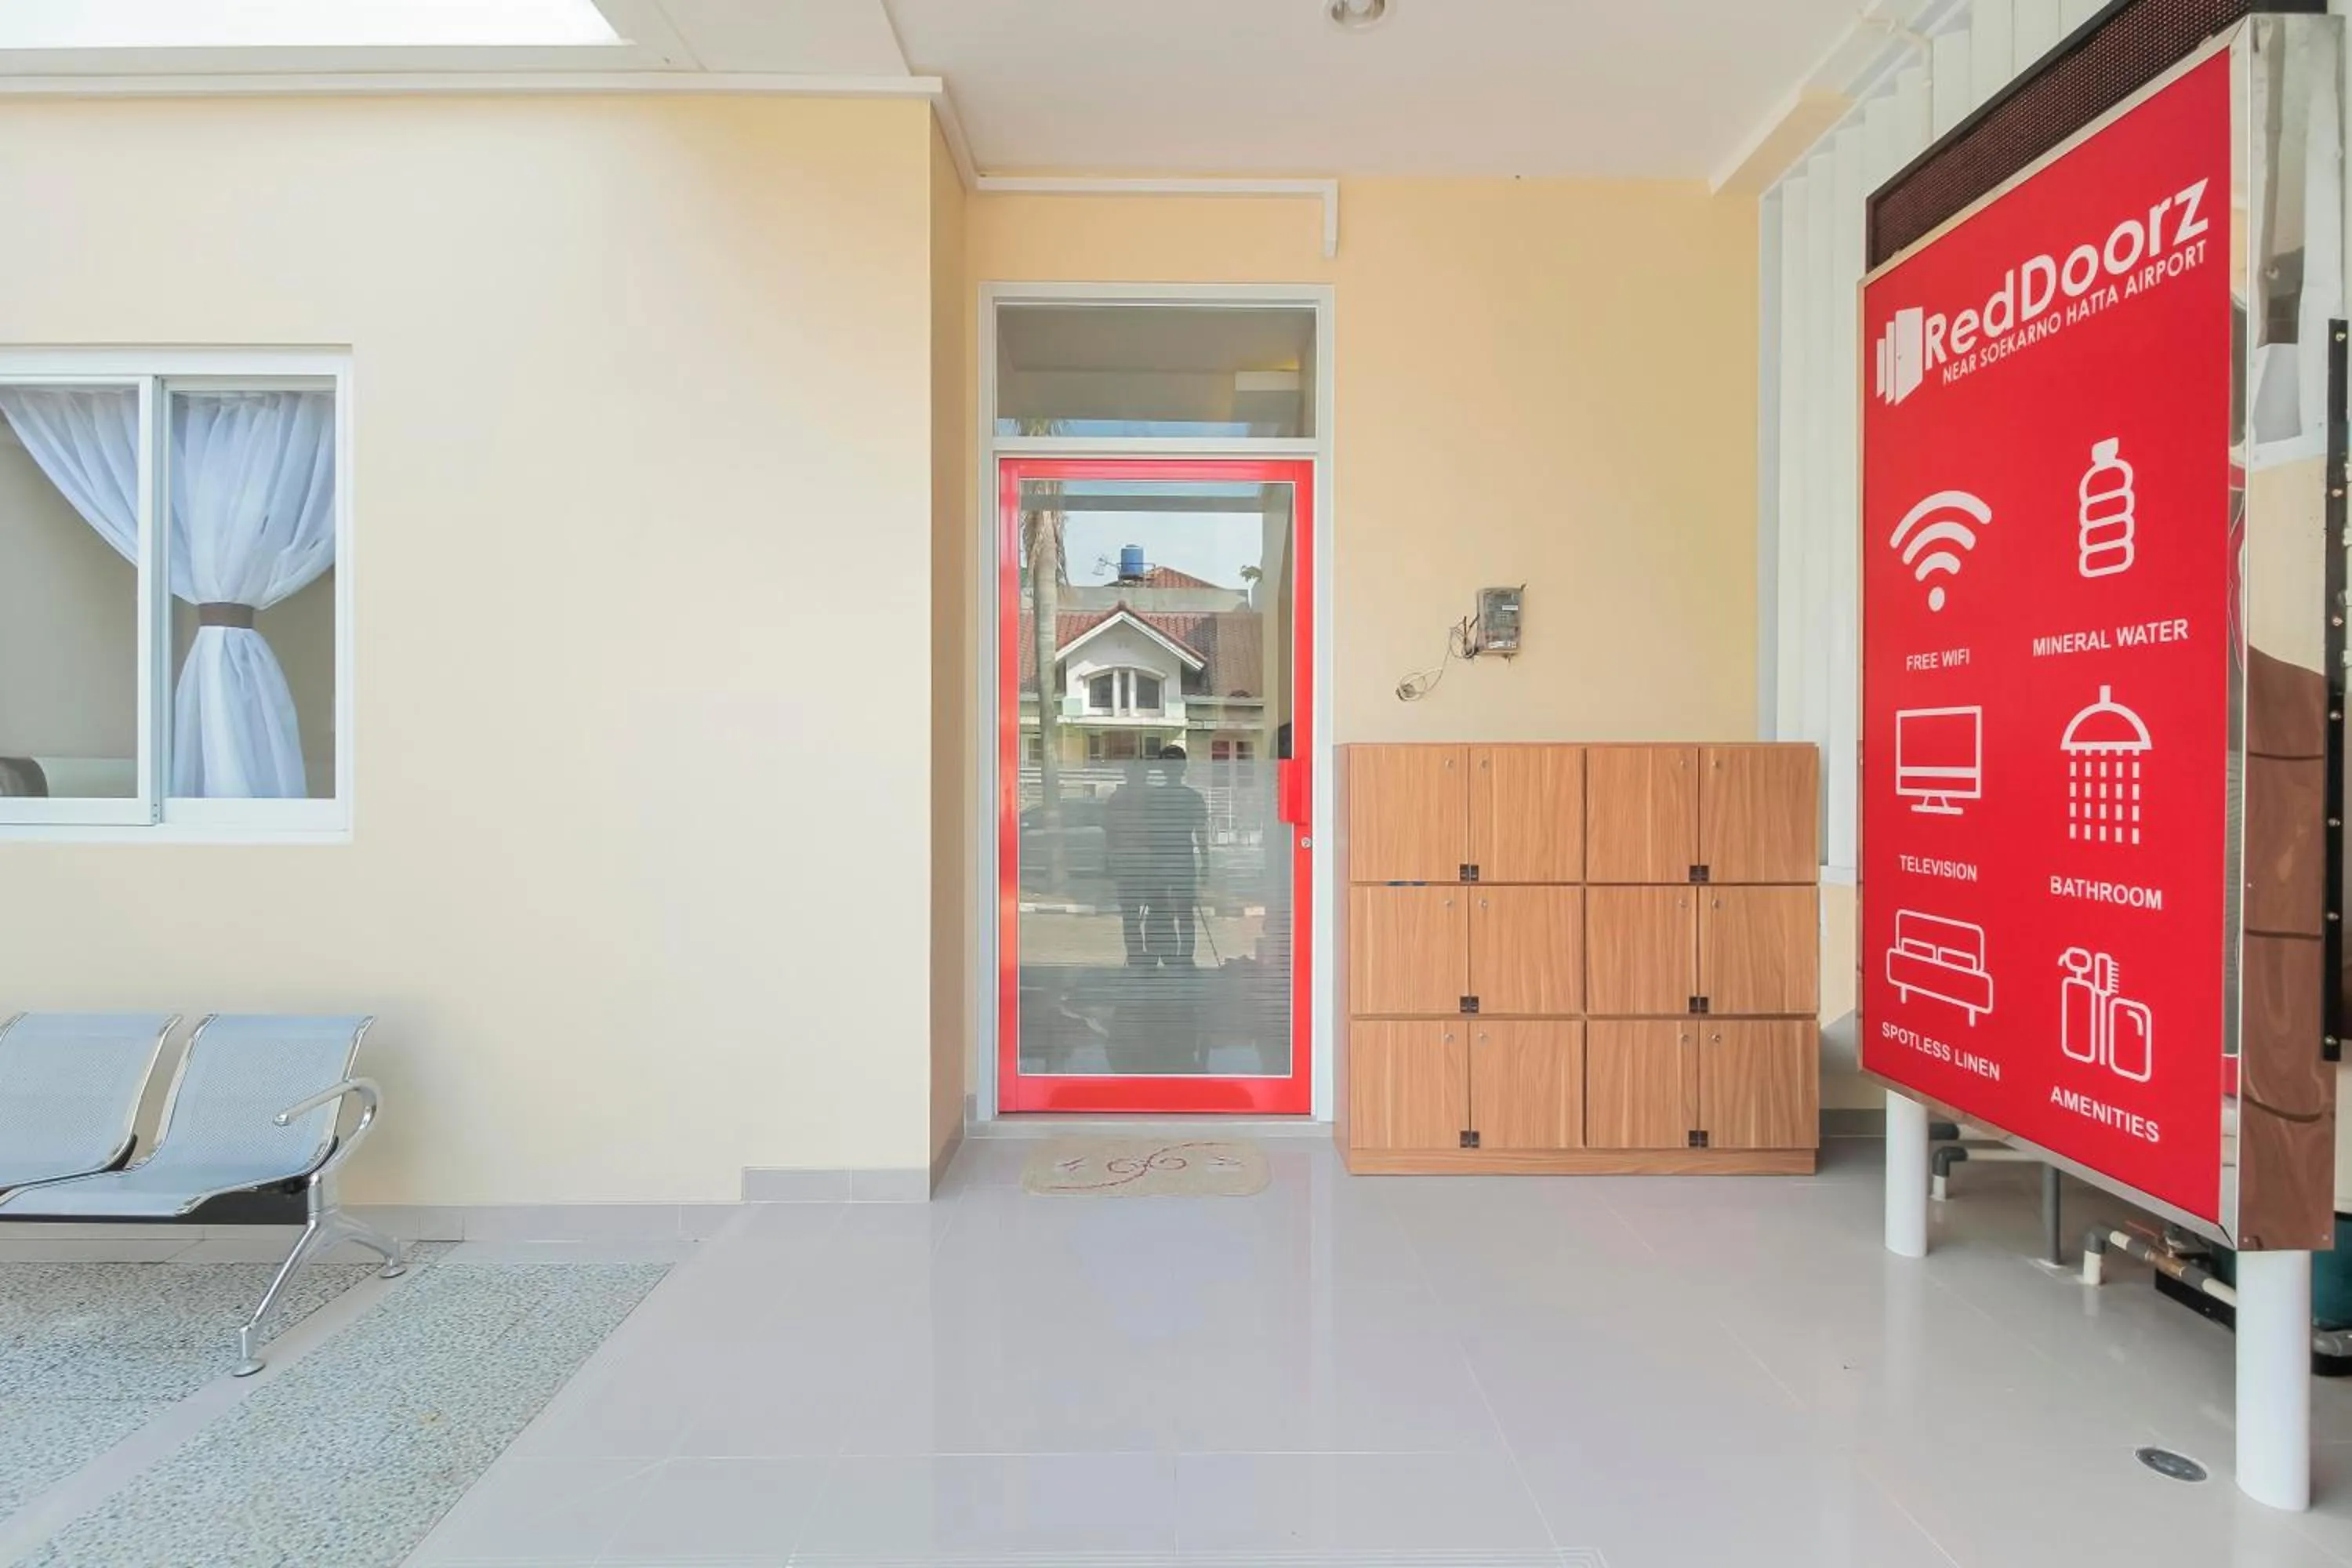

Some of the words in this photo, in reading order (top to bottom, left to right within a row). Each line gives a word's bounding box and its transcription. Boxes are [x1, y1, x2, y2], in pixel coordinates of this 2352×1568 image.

[1926, 178, 2209, 370] RedDoorz
[1943, 354, 1976, 384] NEAR
[1980, 312, 2061, 367] SOEKARNO
[2066, 285, 2118, 327] HATTA
[2125, 239, 2207, 299] AIRPORT
[1906, 652, 1938, 671] FREE
[1942, 648, 1970, 667] WIFI
[2032, 630, 2111, 657] MINERAL
[2116, 618, 2189, 648] WATER
[1899, 855, 1977, 881] TELEVISION
[2049, 875, 2161, 910] BATHROOM
[1882, 1022, 1951, 1064] SPOTLESS
[1955, 1048, 2000, 1081] LINEN
[2050, 1087, 2160, 1142] AMENITIES
